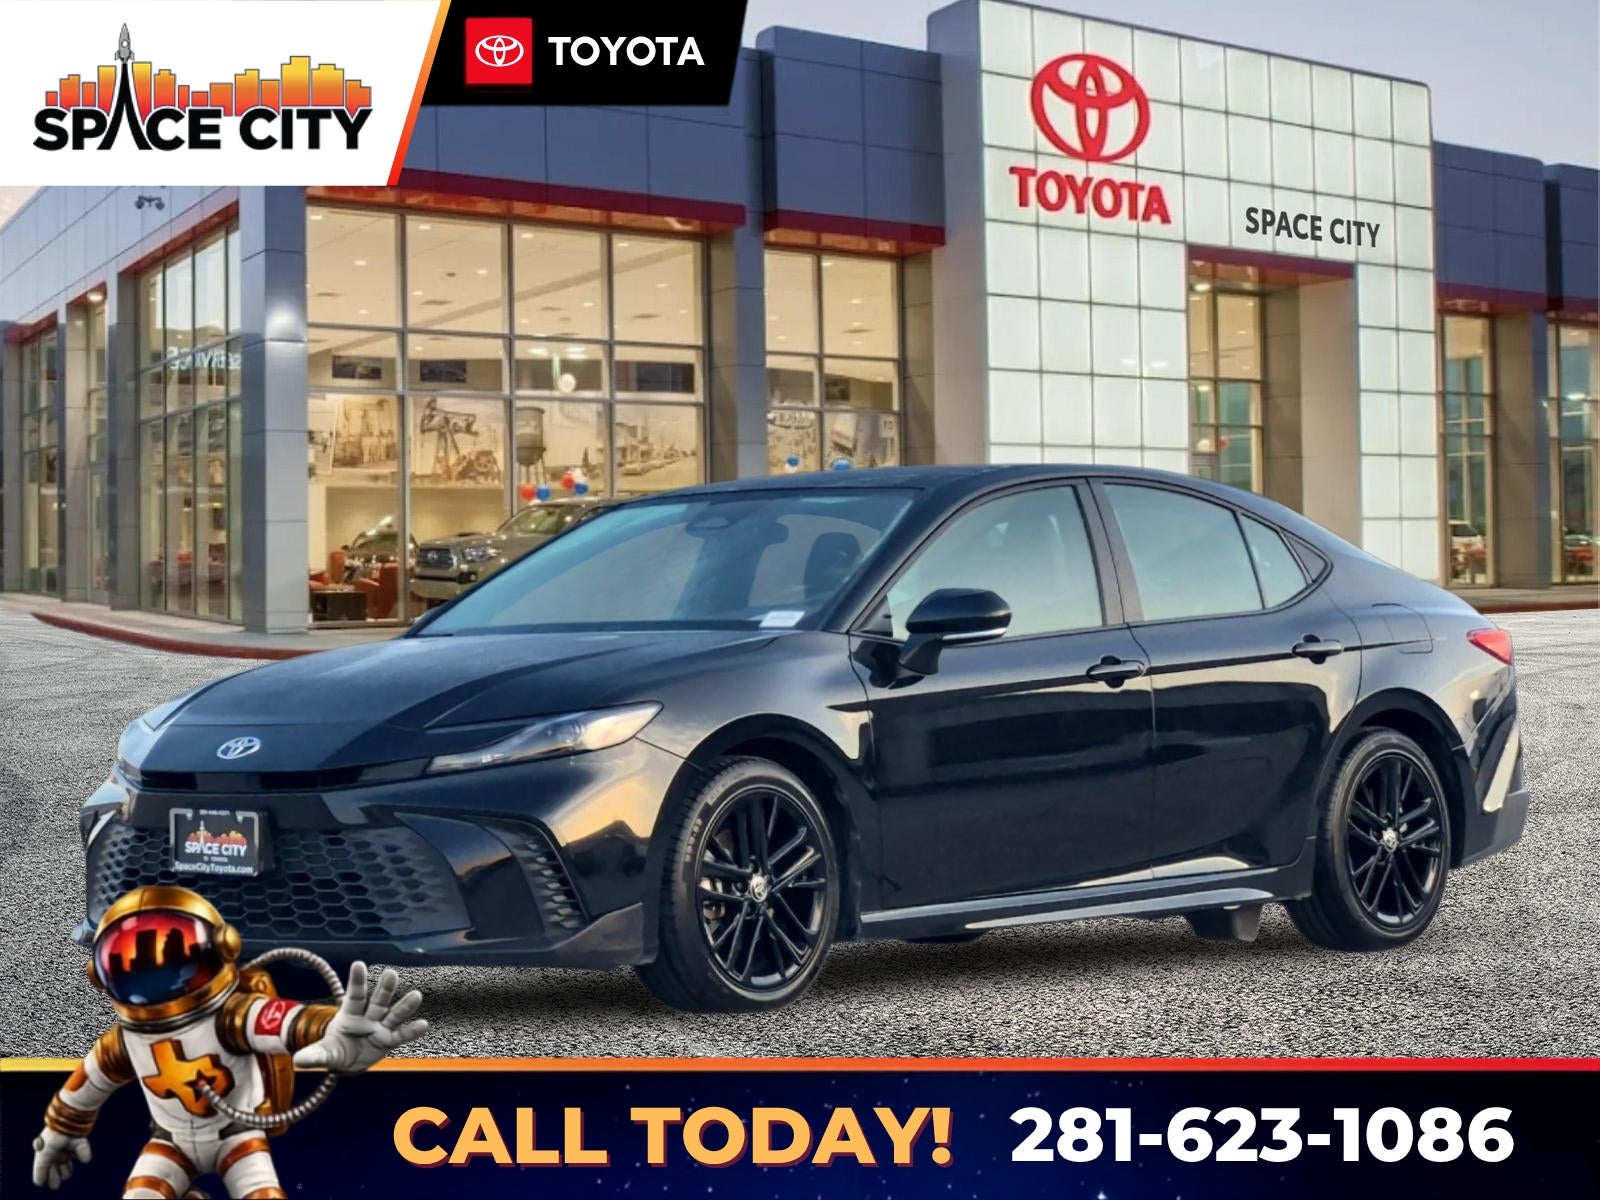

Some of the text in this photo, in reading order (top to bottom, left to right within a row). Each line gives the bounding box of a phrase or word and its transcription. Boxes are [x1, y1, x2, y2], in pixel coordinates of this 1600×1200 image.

[1009, 166, 1172, 225] TOYOTA
[1245, 206, 1381, 248] SPACE CITY
[185, 841, 247, 856] SPACE CITY
[174, 861, 254, 874] SpaceCityToyota.com
